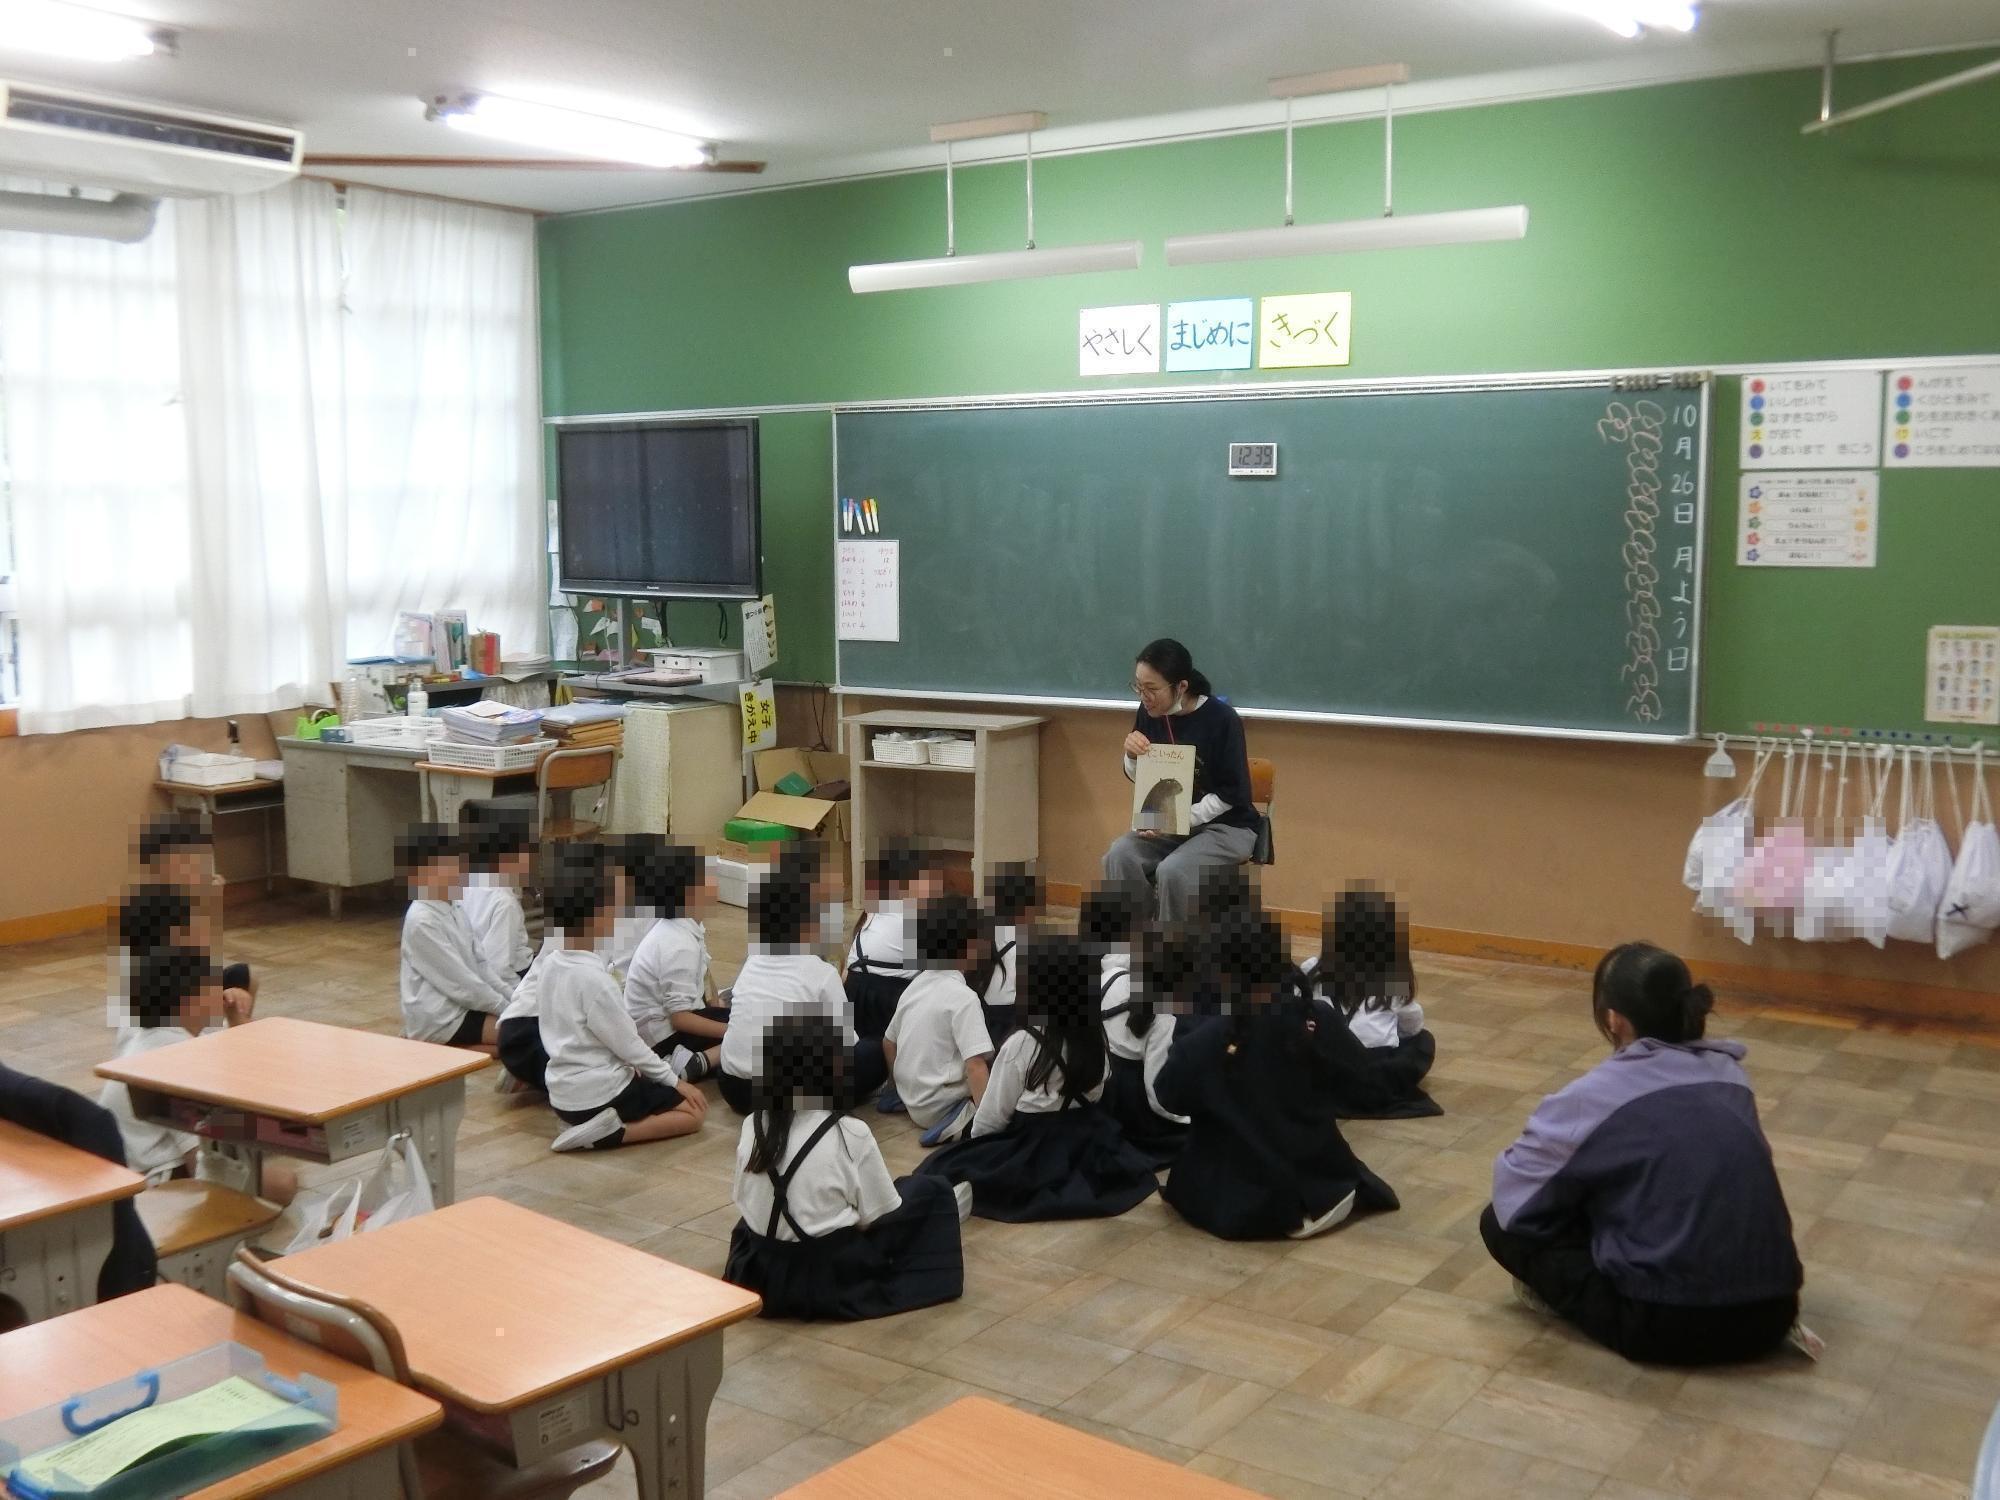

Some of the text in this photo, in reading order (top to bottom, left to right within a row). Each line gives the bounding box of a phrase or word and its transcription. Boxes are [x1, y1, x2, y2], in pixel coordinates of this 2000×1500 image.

[1082, 324, 1152, 356] やさしく
[1170, 318, 1250, 351] まじめに
[1270, 311, 1338, 348] きづく
[1667, 404, 1697, 671] 10月26日 月よう日
[744, 691, 758, 744] きがえ中
[760, 700, 772, 729] 女子
